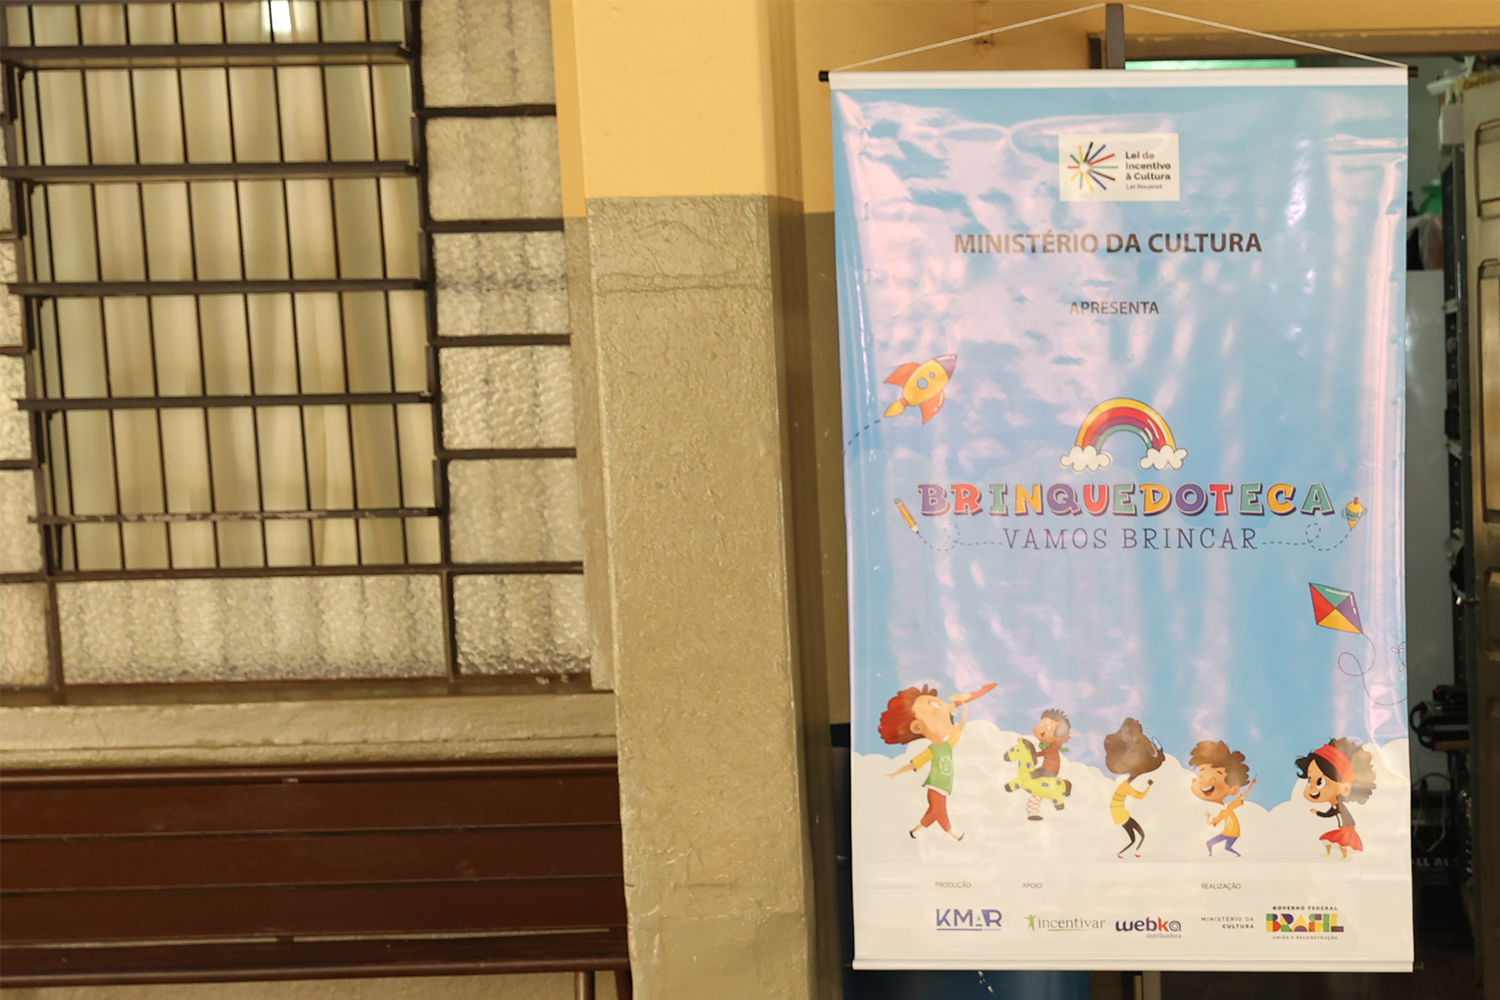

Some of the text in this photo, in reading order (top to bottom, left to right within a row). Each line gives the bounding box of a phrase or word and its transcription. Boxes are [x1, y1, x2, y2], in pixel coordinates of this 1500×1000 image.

[1125, 161, 1172, 170] Incentivo
[1134, 172, 1171, 181] Cultura
[954, 229, 1262, 253] MINISTÉRIO DA CULTURA
[1069, 301, 1160, 314] APRESENTA
[917, 482, 1336, 517] BRINQUEDOTECA
[1002, 527, 1259, 550] VAMOS BRINCAR
[935, 881, 972, 890] PRODUÇÃO
[1201, 882, 1241, 891] REALIZAÇÃO
[1038, 915, 1106, 930] incentivar
[1115, 917, 1182, 933] webka
[1265, 913, 1344, 932] BRASIL
